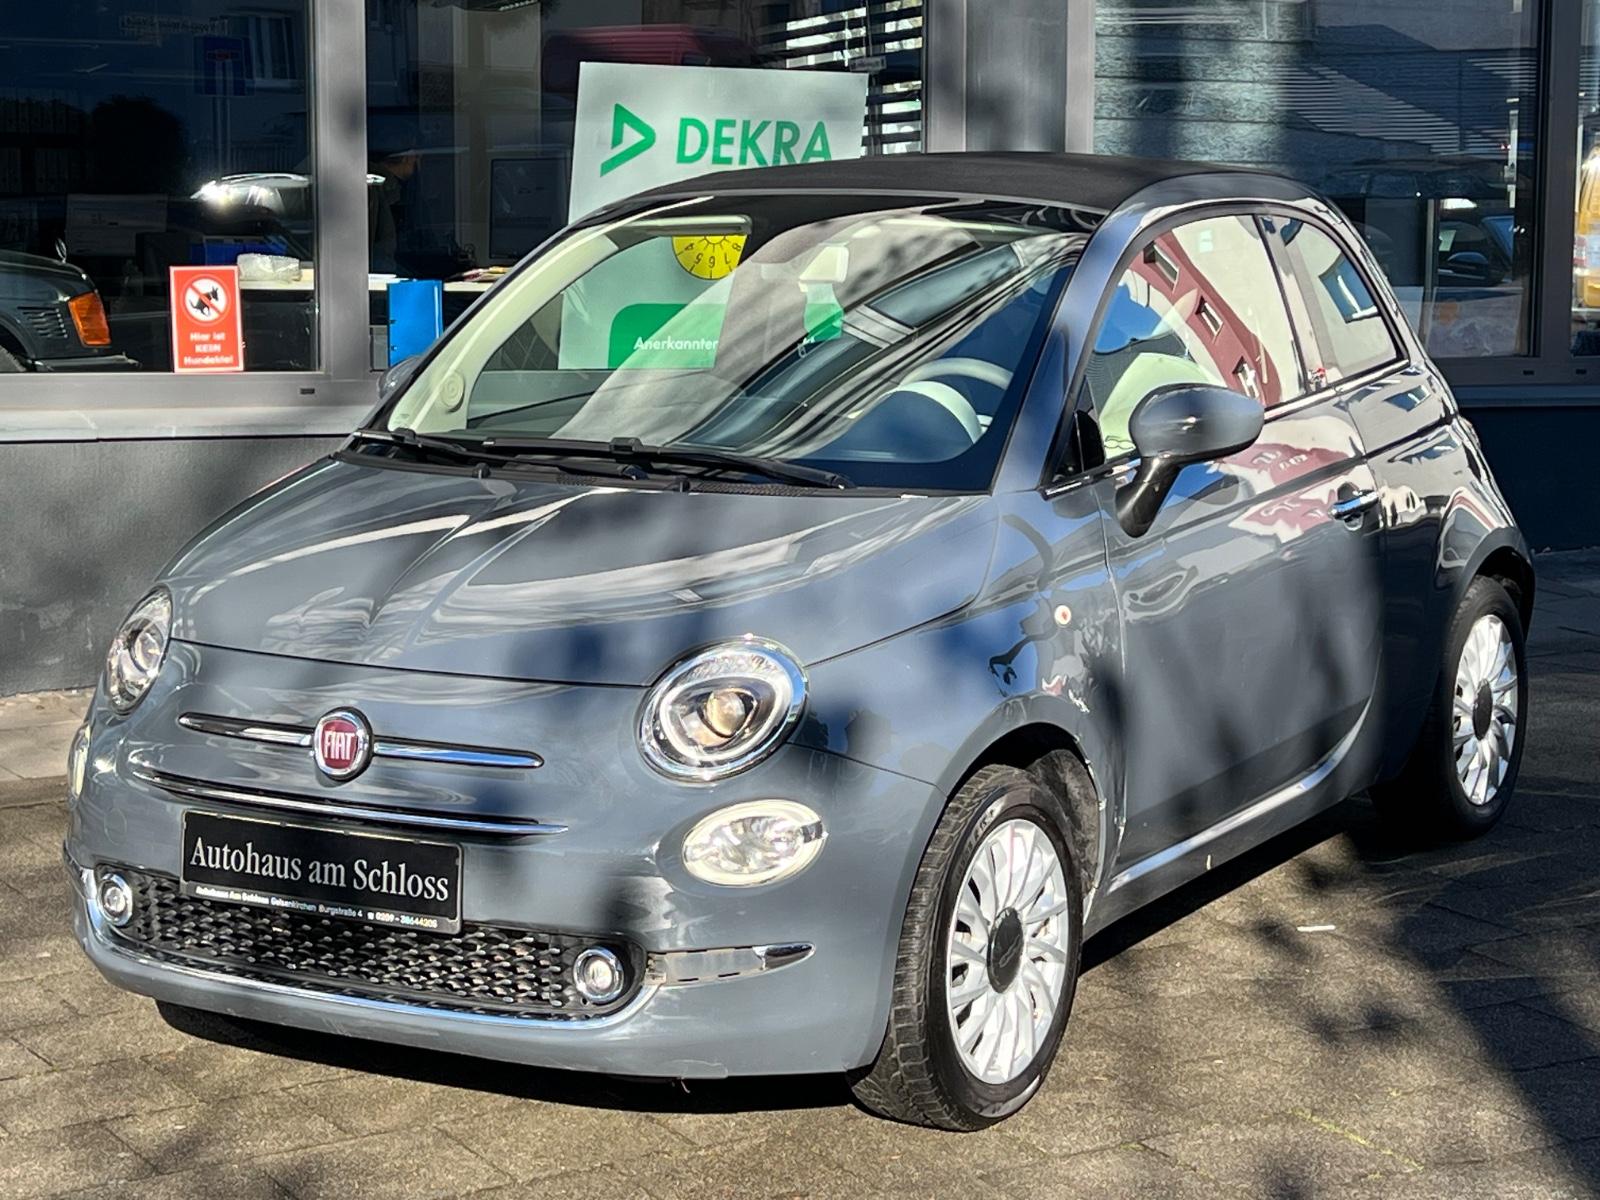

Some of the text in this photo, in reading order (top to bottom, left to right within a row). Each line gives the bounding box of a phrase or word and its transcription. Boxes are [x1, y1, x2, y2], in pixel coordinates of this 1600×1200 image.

[676, 117, 832, 167] DEKRA
[695, 253, 704, 265] 5
[708, 256, 716, 269] 6
[195, 344, 221, 353] KEIN
[633, 336, 719, 351] Anerkannter
[324, 730, 356, 760] FIAT
[189, 836, 449, 901] Autohaus am Schloss
